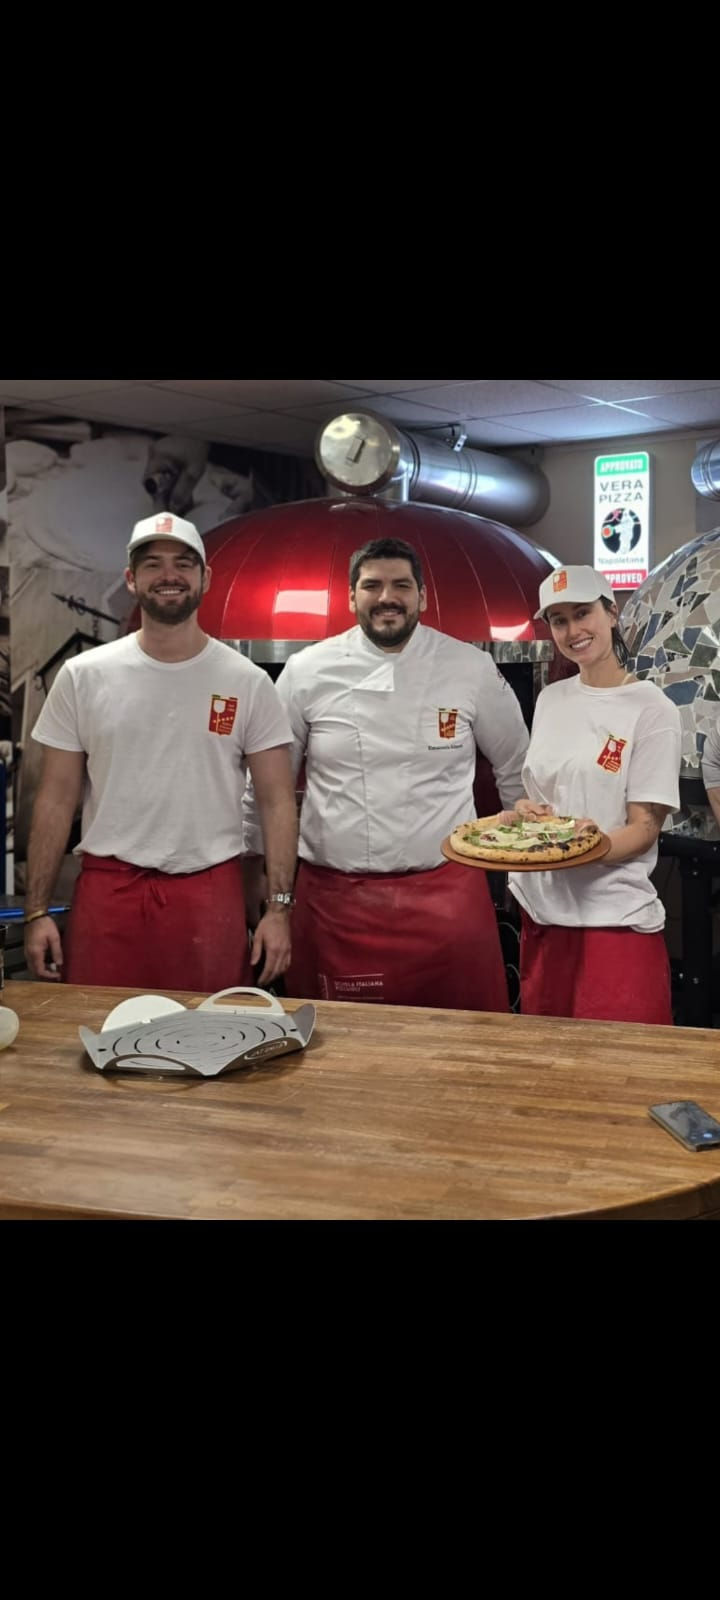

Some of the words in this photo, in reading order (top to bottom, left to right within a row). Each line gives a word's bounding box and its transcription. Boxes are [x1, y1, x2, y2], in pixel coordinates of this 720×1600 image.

[600, 480, 643, 492] VERA
[599, 492, 643, 504] PIZZA
[604, 573, 643, 584] PPROVED
